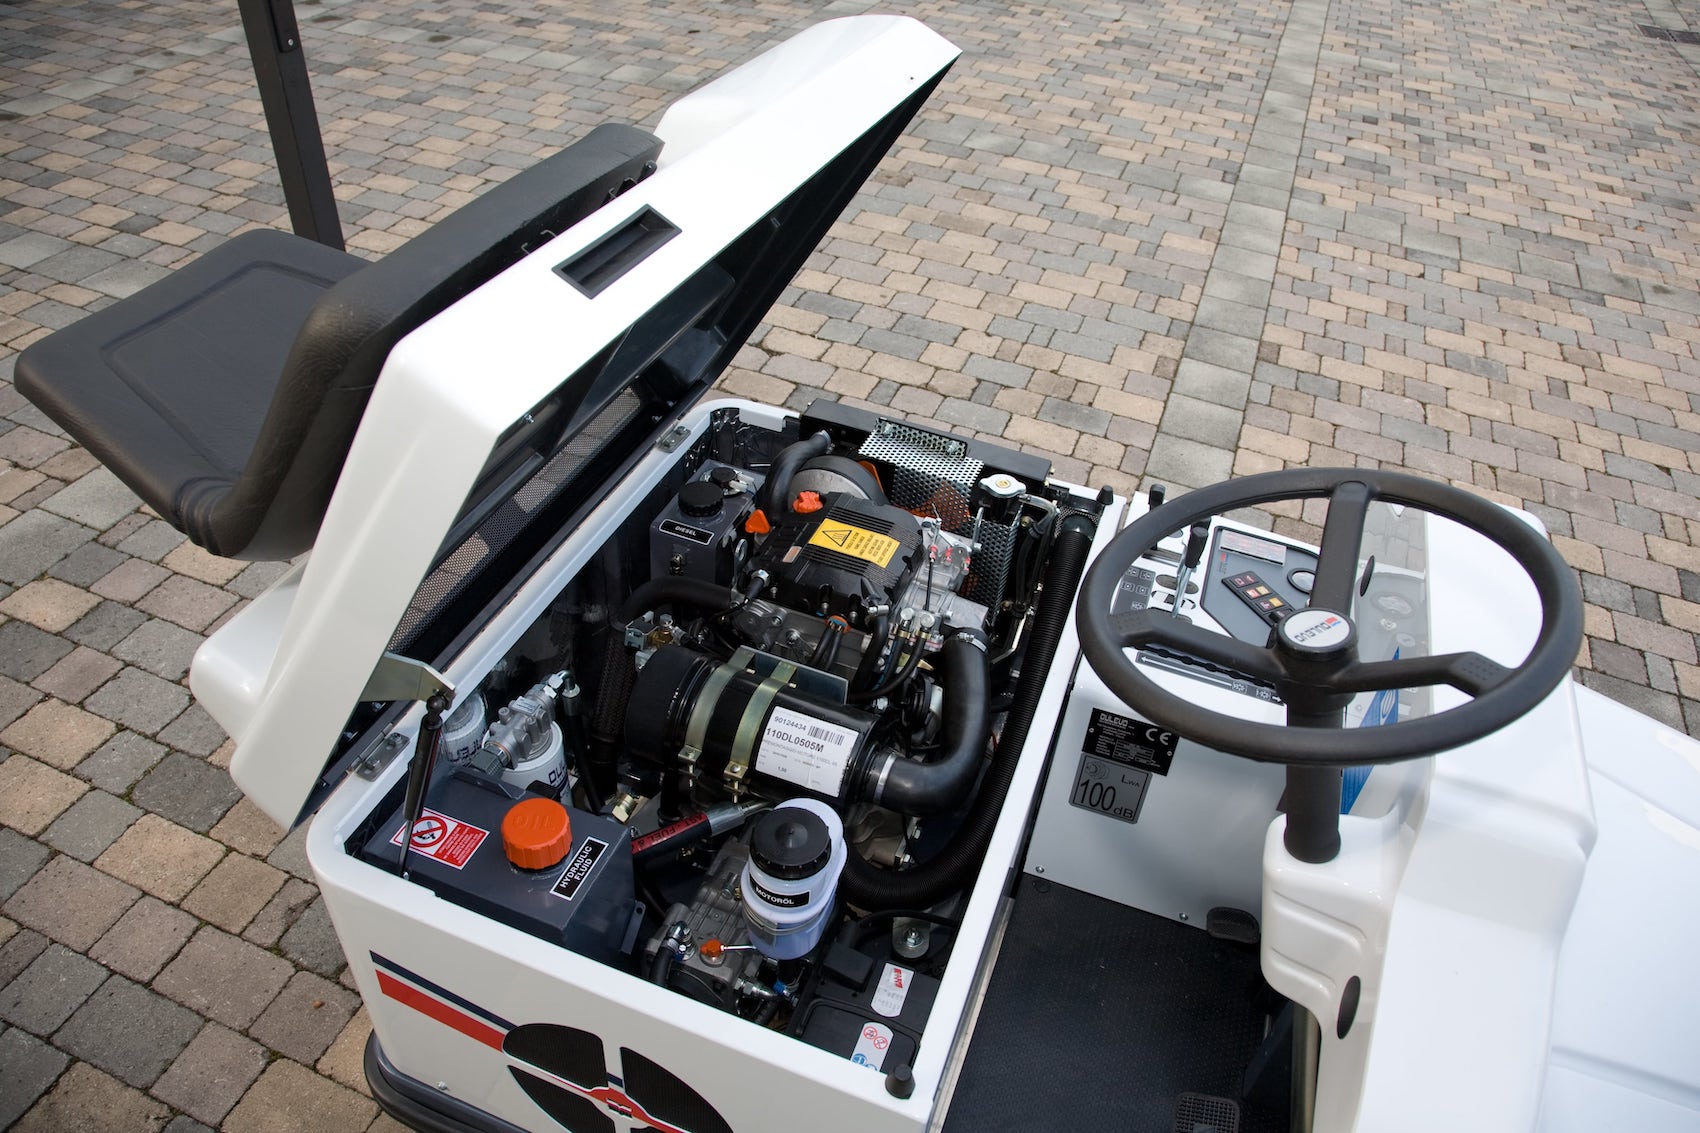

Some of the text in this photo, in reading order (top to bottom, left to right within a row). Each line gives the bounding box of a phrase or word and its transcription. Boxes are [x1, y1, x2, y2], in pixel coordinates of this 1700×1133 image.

[675, 526, 697, 536] DIESEL
[1294, 622, 1331, 642] DULEVO
[774, 716, 807, 731] 90124434
[1100, 713, 1129, 727] DULEVO
[766, 728, 824, 753] 110DL0505M
[1145, 728, 1172, 745] CE
[1080, 779, 1134, 819] 100 dB
[647, 826, 676, 842] FUEL
[559, 846, 593, 889] HYDRAULIC
[574, 858, 593, 881] FLUID
[755, 886, 795, 904] MOTORÖL
